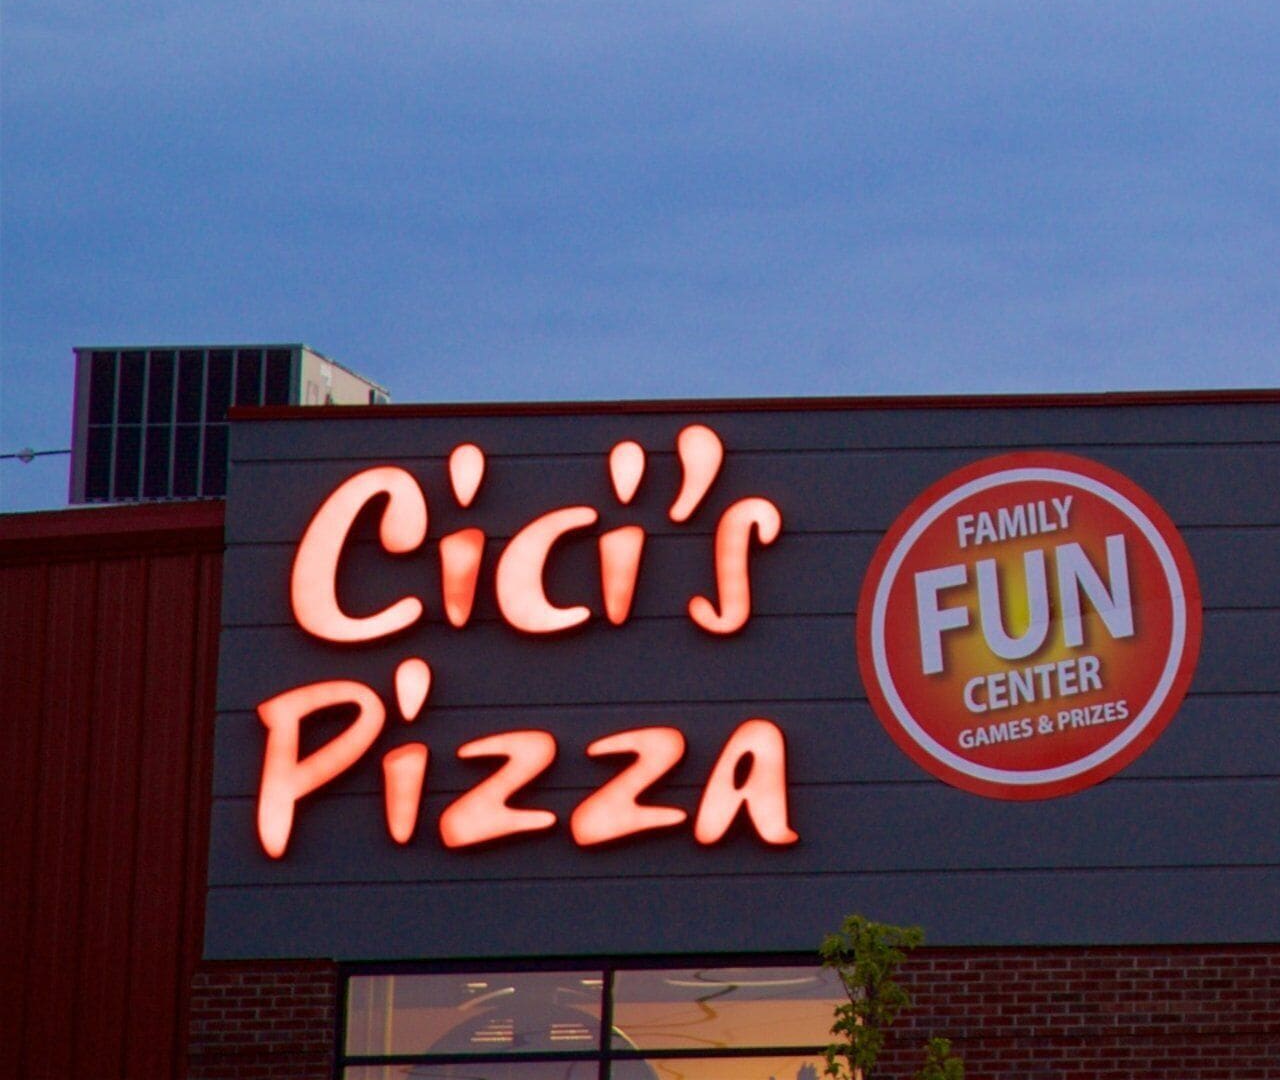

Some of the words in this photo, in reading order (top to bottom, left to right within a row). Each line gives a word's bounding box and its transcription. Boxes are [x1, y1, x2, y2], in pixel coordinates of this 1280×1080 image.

[288, 424, 783, 645] Cici's
[956, 495, 1074, 548] FAMILY
[914, 533, 1135, 675] FUN
[957, 718, 1034, 750] GAMES
[1037, 715, 1054, 734] &
[1057, 700, 1130, 732] PRIZES
[962, 655, 1103, 714] CENTER
[255, 656, 800, 860] Pizza
